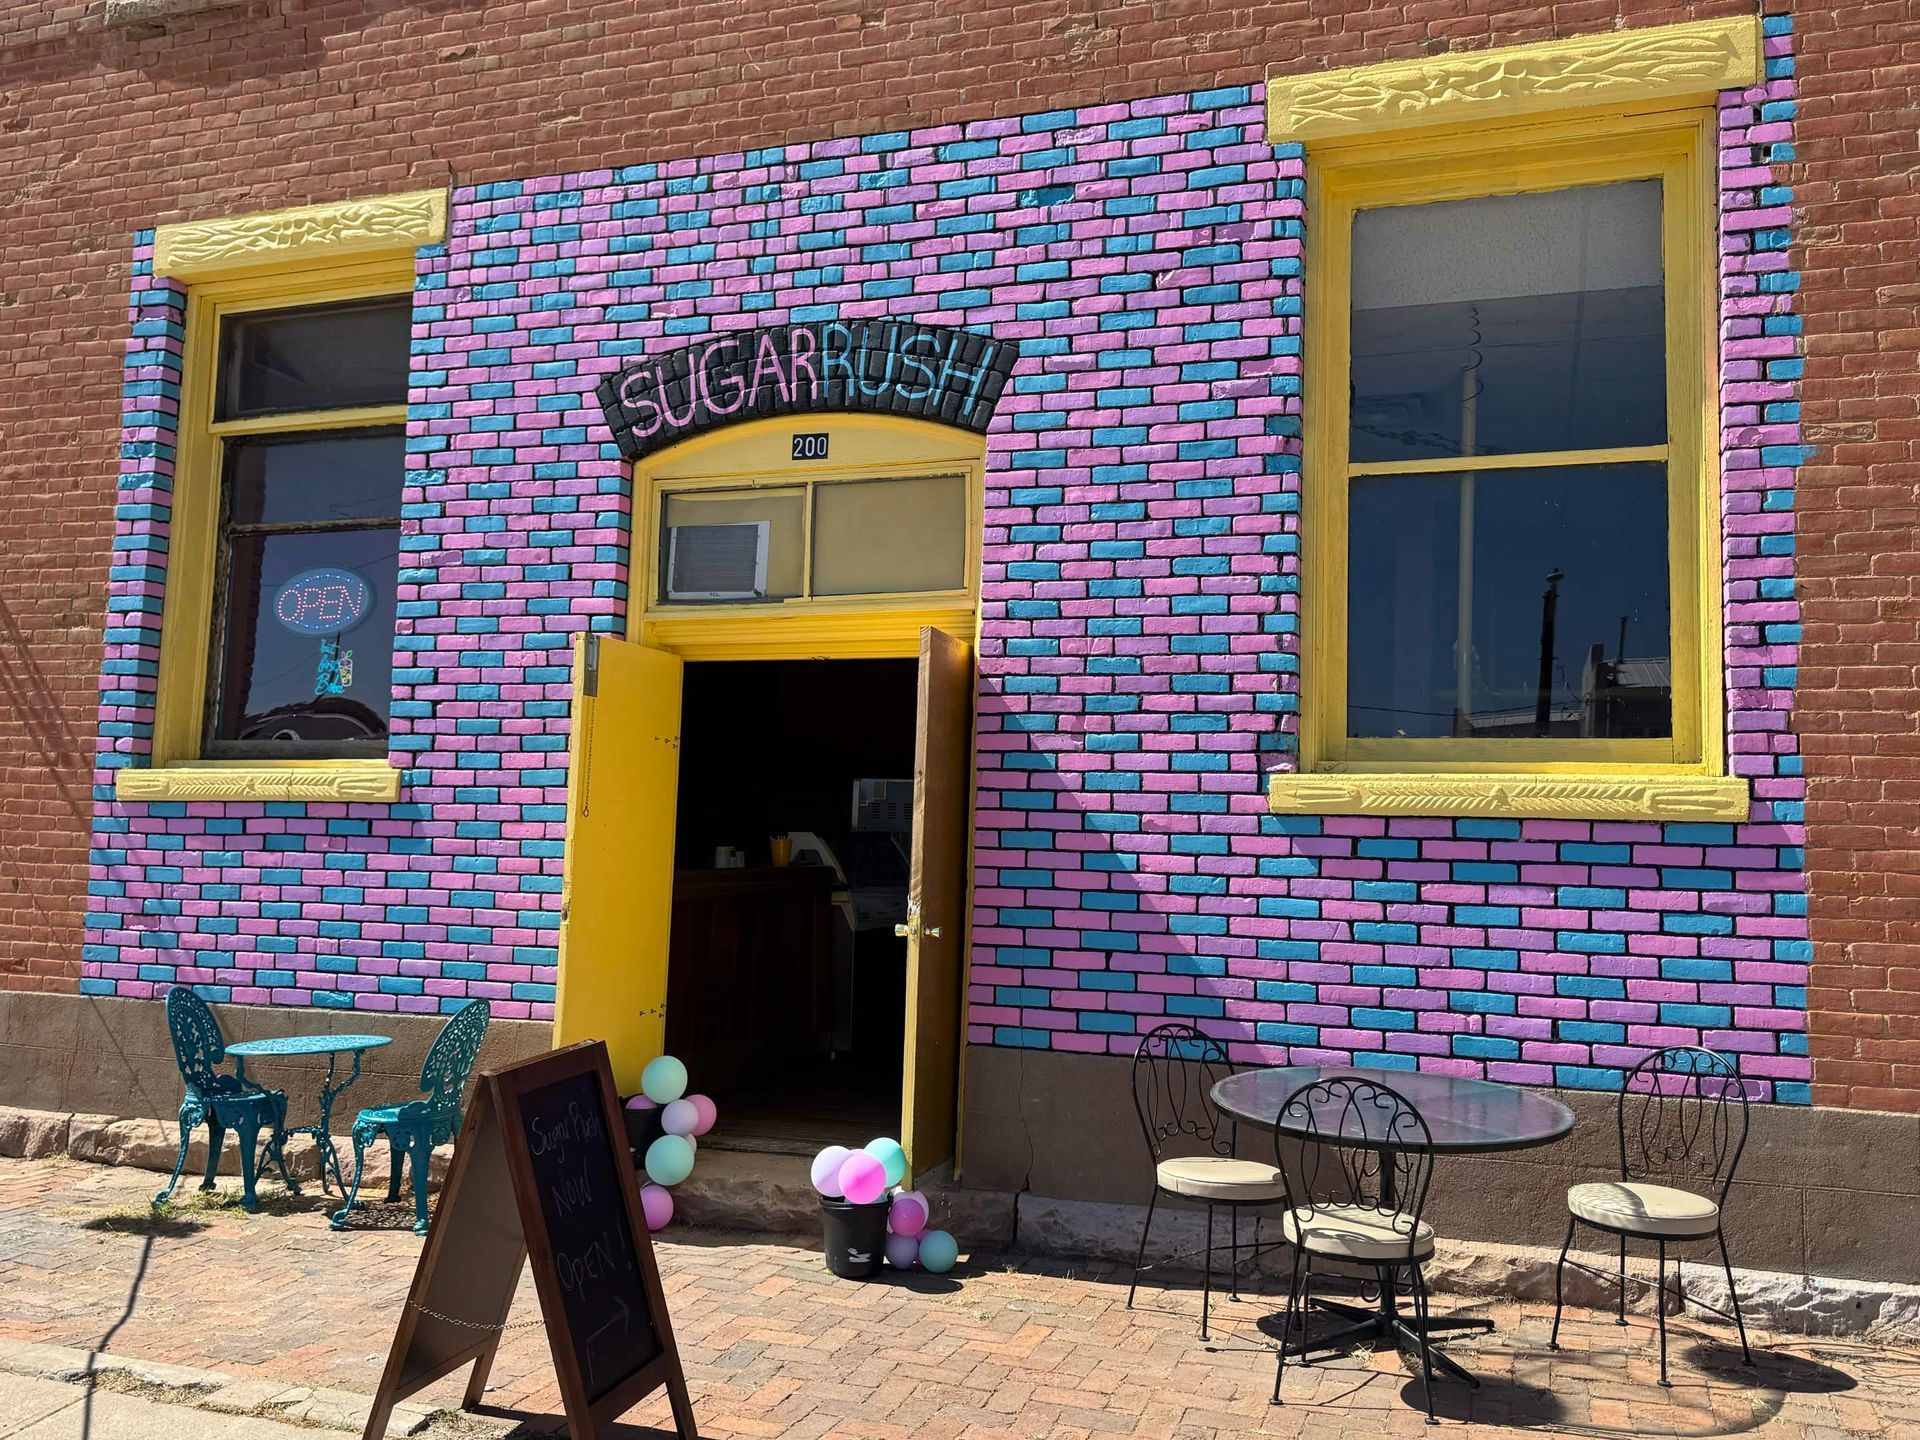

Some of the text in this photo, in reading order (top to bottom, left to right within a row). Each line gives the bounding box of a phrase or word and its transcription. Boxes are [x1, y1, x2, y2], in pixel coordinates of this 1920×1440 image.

[619, 321, 994, 438] SUGAR RUSH
[793, 435, 828, 458] 200
[278, 583, 363, 621] OPEN
